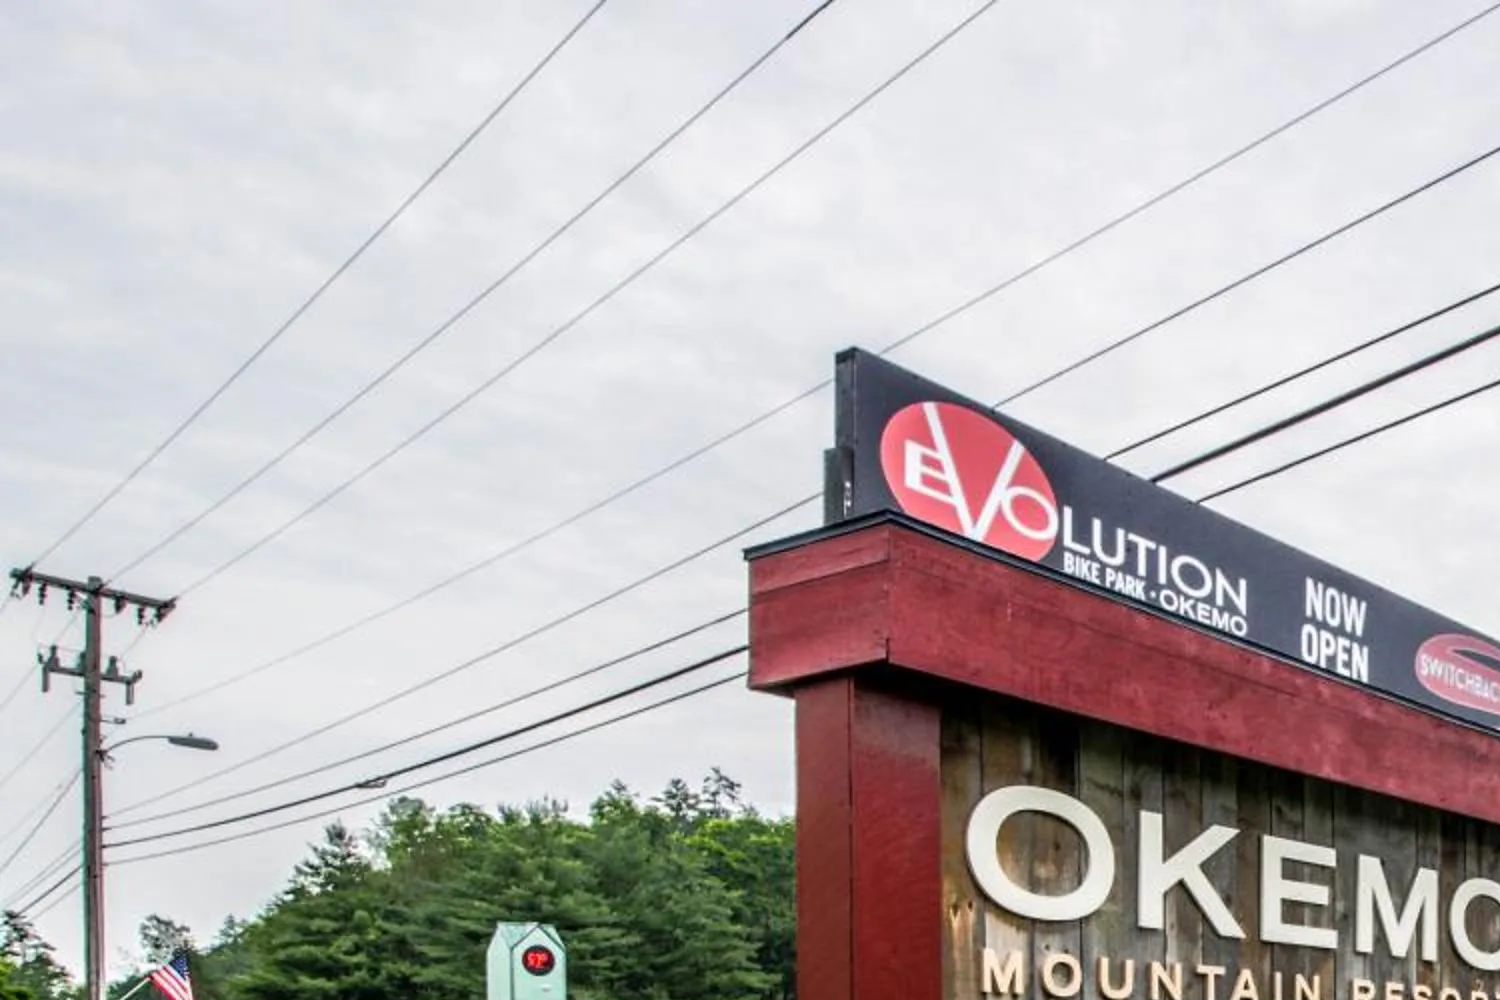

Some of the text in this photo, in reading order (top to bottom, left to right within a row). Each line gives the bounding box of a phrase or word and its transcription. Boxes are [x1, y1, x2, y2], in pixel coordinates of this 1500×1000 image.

[1063, 551, 1101, 584] BIKE
[1105, 567, 1147, 600] PARK
[1159, 589, 1247, 637] OKEMO
[1305, 576, 1367, 637] NOW
[1301, 624, 1369, 684] OPEN
